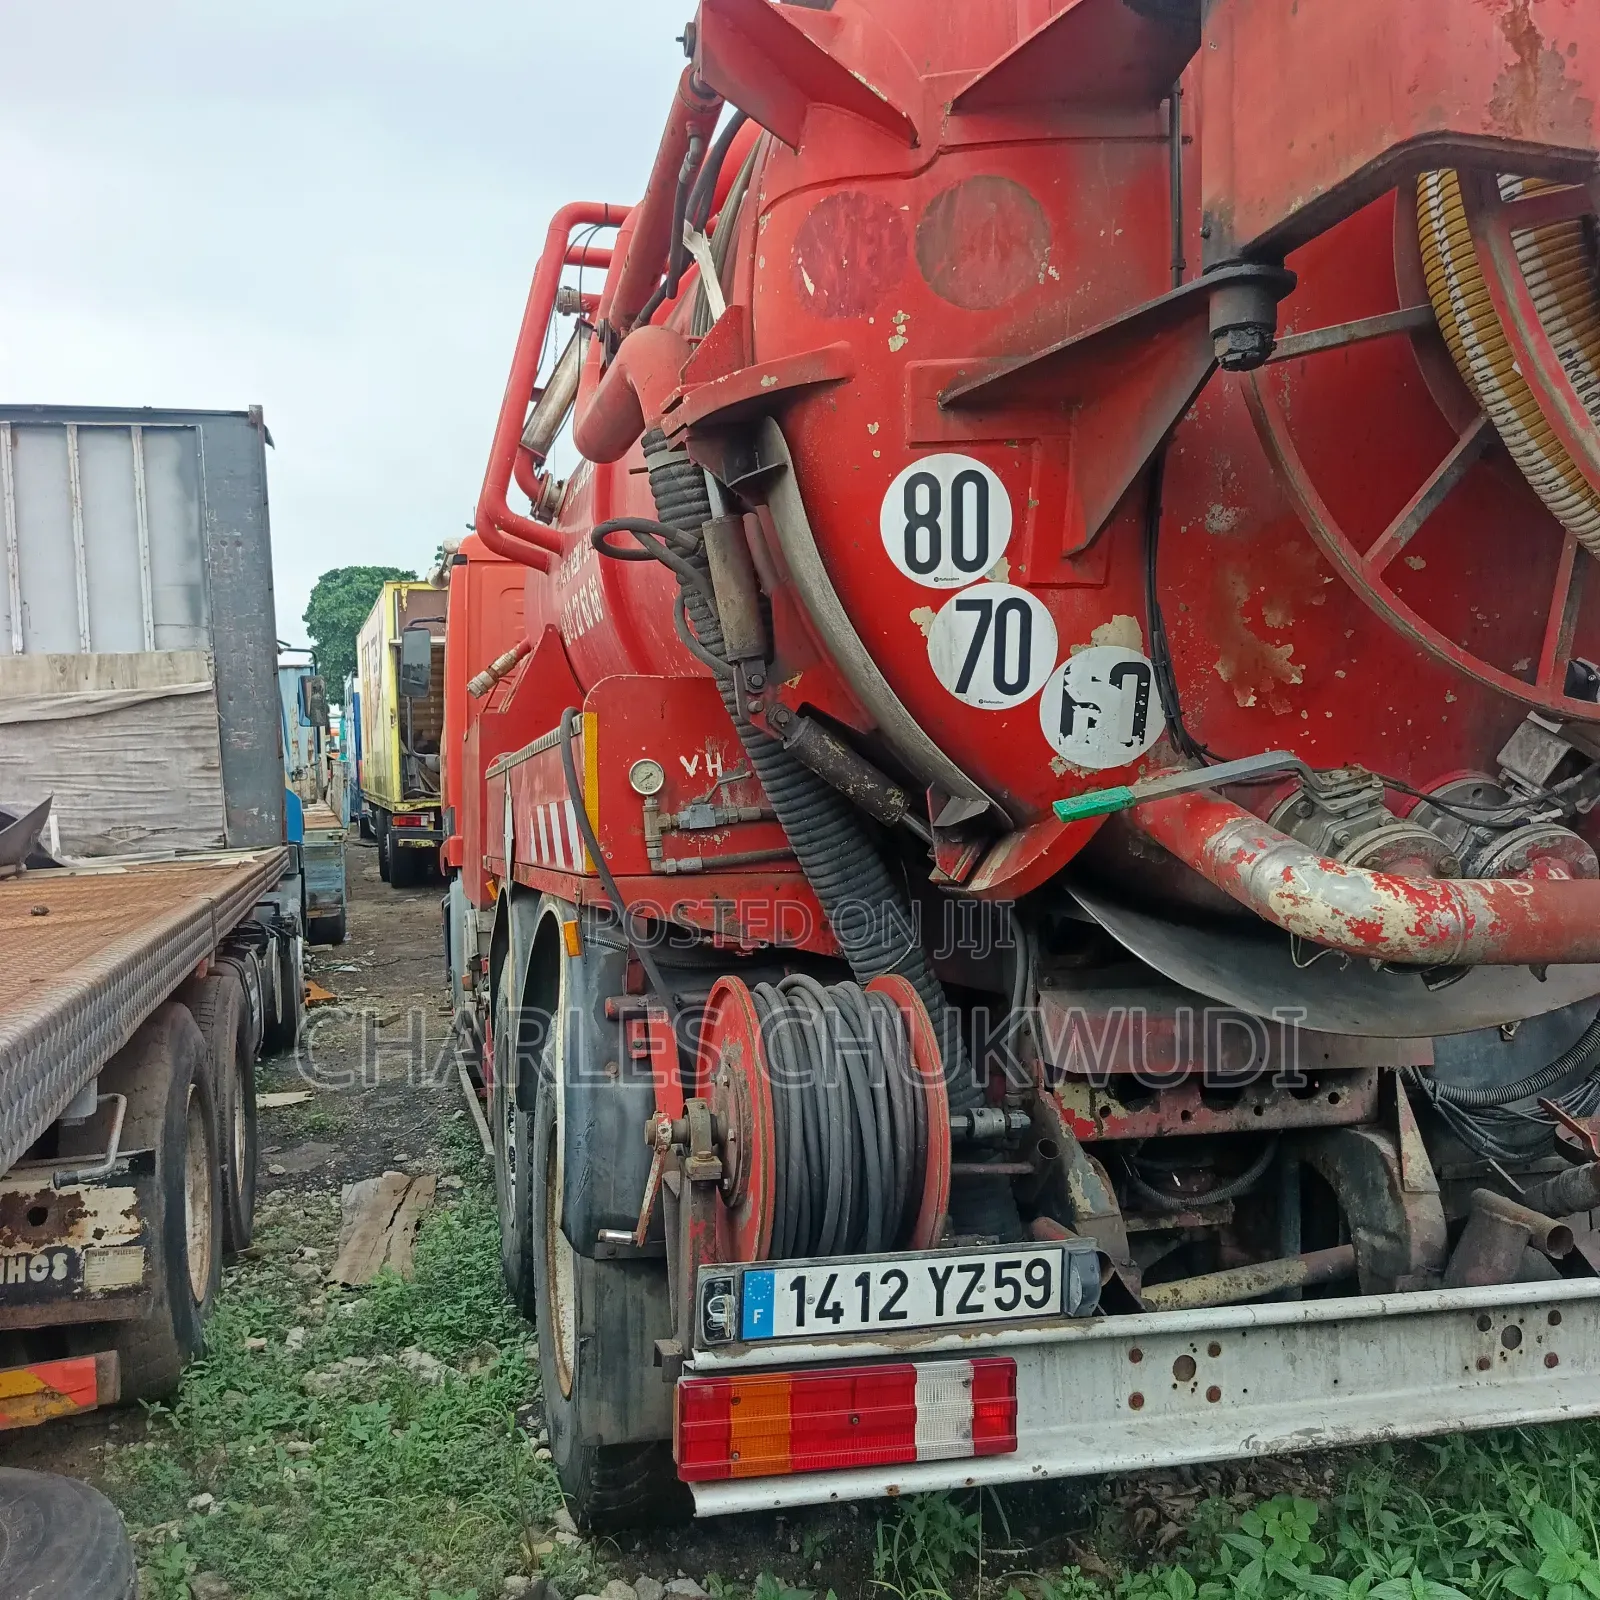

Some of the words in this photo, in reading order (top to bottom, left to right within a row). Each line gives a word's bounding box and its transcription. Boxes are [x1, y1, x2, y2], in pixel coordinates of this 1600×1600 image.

[903, 469, 989, 575] 80
[954, 597, 1032, 696] 70
[0, 1252, 68, 1285] HOS
[789, 1268, 909, 1327] 1412
[752, 1309, 764, 1324] F
